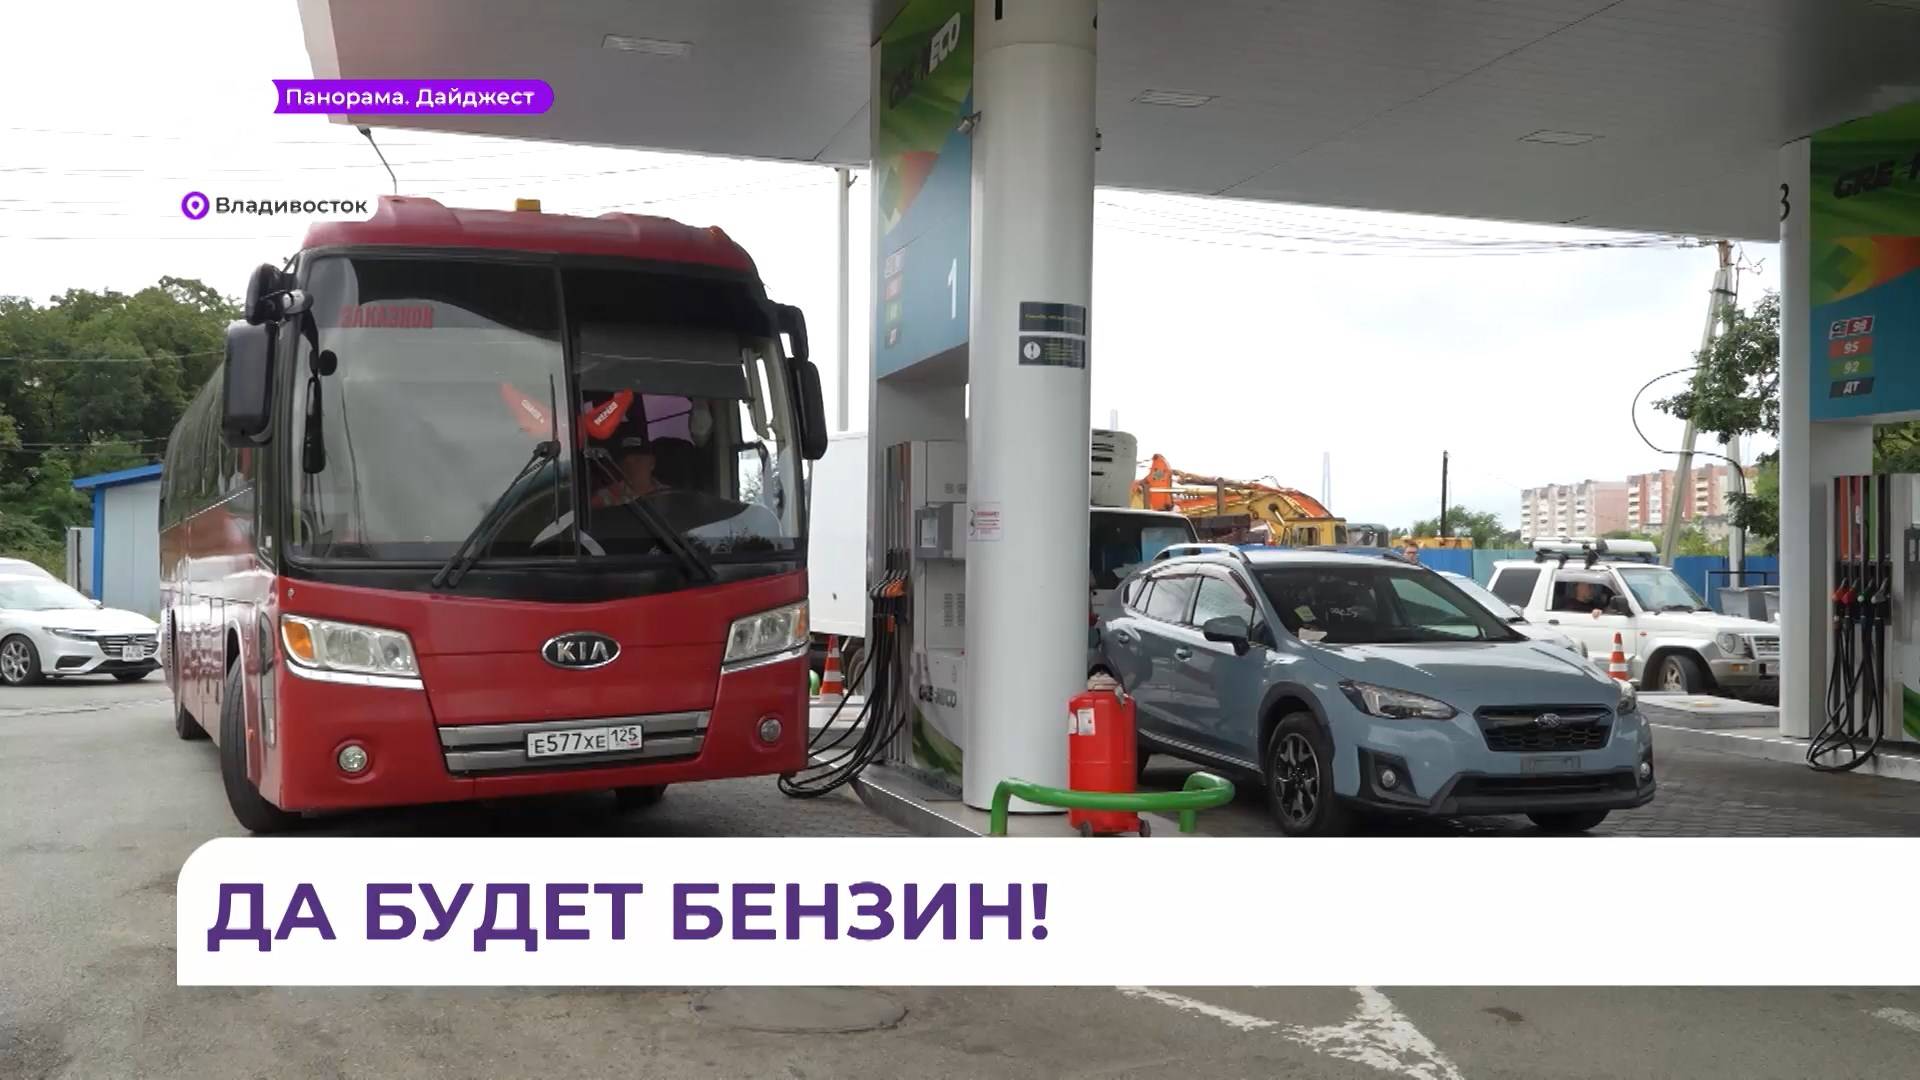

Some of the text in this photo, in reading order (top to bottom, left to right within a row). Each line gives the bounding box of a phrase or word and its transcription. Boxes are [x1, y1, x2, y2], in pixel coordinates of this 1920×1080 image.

[947, 257, 958, 320] 1
[1843, 341, 1860, 354] 95
[1842, 360, 1860, 375] 92
[557, 641, 609, 662] KIA
[534, 728, 638, 754] Е577ХЕ 125
